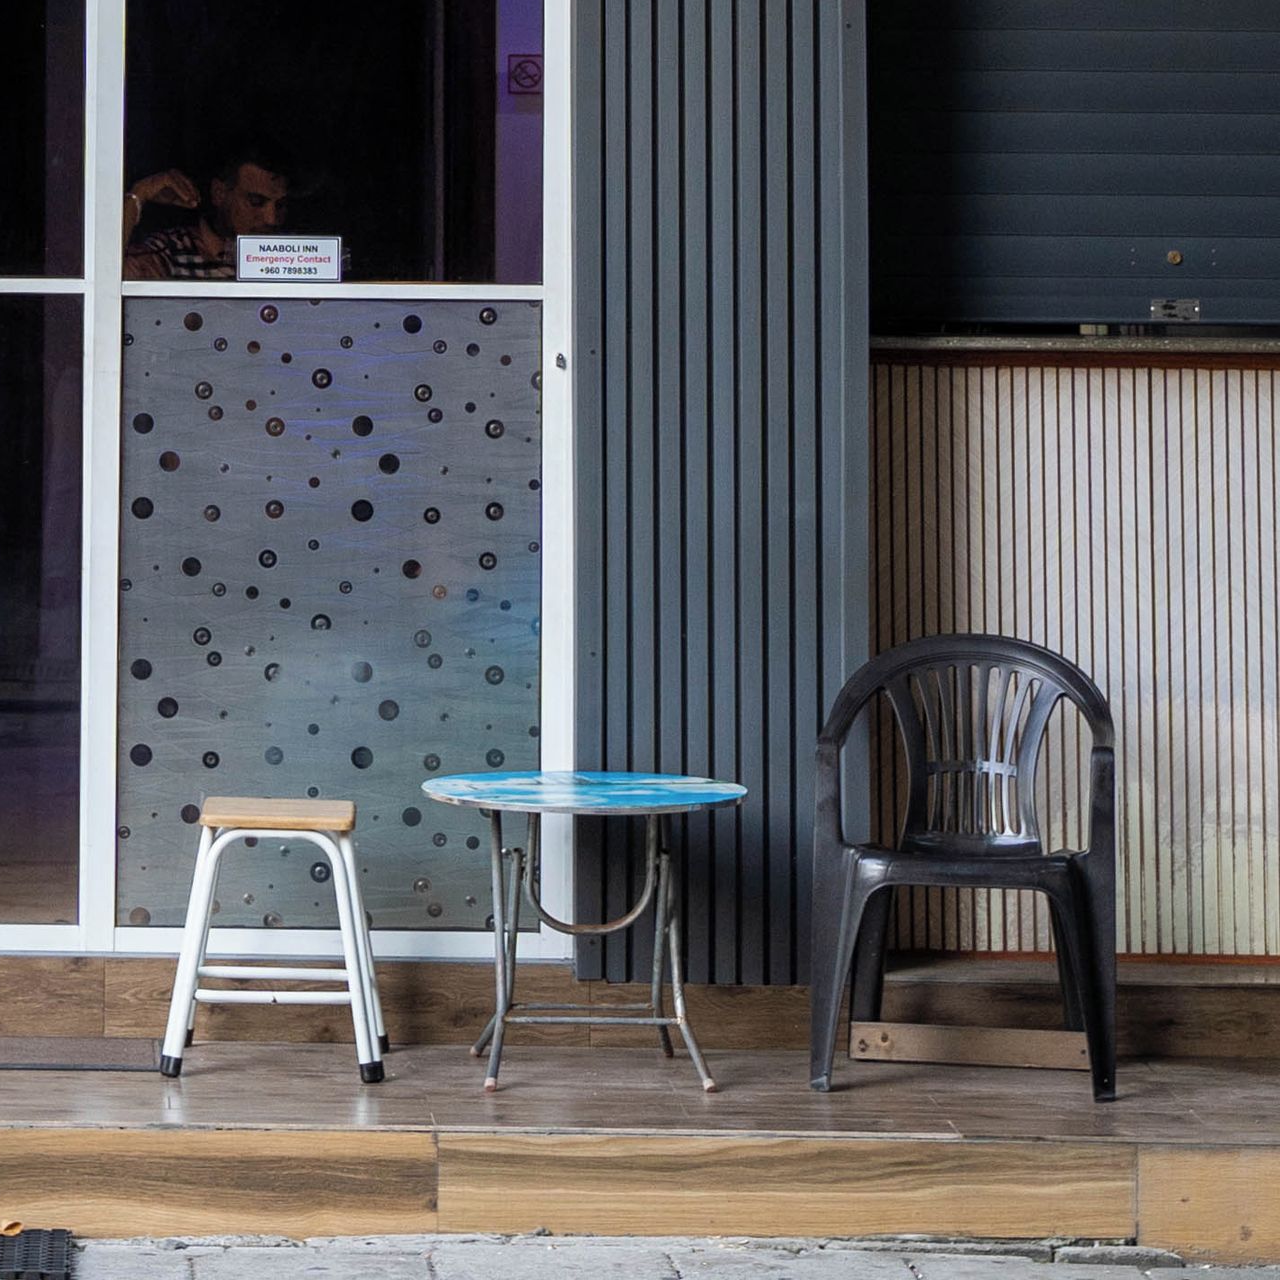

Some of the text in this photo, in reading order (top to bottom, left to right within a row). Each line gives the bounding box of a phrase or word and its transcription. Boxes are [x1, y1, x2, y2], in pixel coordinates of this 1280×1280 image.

[259, 244, 318, 253] NAABOLI INN
[246, 254, 331, 265] Emergency Contact
